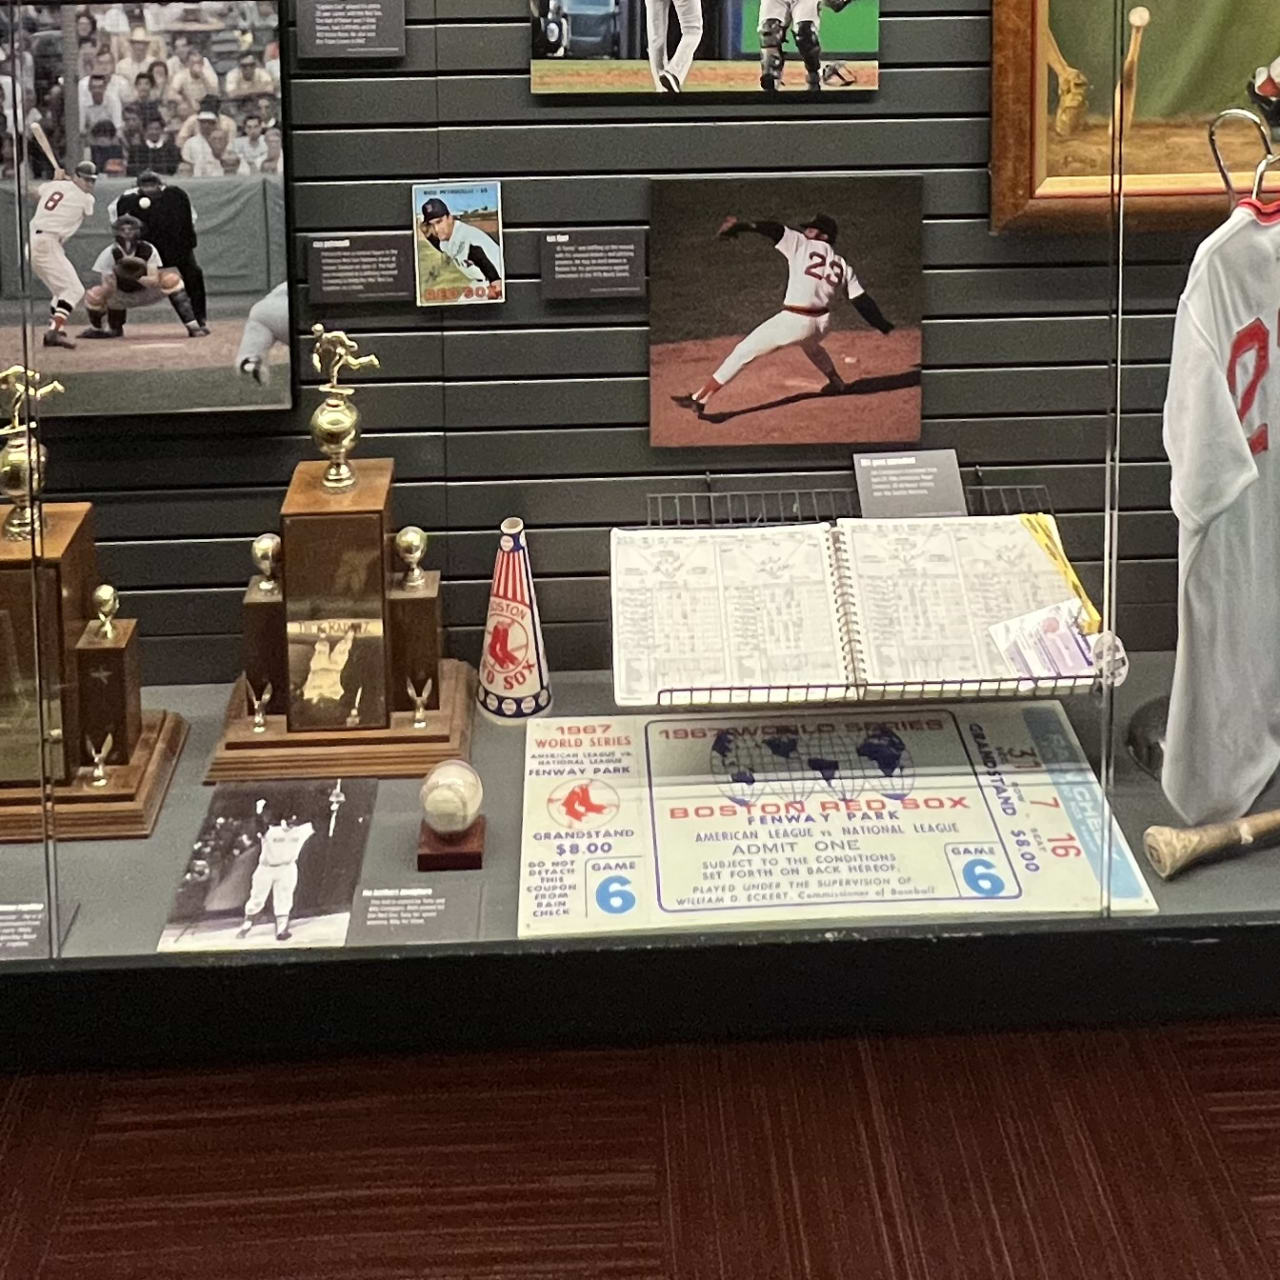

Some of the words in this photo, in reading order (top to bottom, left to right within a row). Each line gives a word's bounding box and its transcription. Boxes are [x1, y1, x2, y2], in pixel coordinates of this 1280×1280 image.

[44, 191, 64, 211] 8
[804, 251, 844, 288] 23
[503, 660, 536, 691] SOX
[554, 724, 613, 735] 1967
[659, 727, 720, 740] 1967
[725, 722, 836, 738] WORLD
[845, 719, 944, 732] SERIES
[535, 737, 583, 749] WORLD
[589, 736, 632, 747] SERIES
[528, 768, 587, 777] FENWAY
[593, 766, 631, 775] PARK
[969, 722, 1017, 817] GRANDSTAND
[1010, 829, 1040, 873] $8.00
[669, 800, 806, 819] BOSTON
[820, 799, 887, 812] RED
[901, 796, 970, 810] SOX
[747, 813, 832, 826] FENWAY
[848, 810, 900, 821] PARK
[532, 829, 635, 841] GRANDSTAND
[695, 831, 759, 843] AMERICAN
[768, 828, 814, 839] LEAGUE
[842, 824, 905, 836] NATIONAL
[914, 823, 960, 834] LEAGUE
[1030, 797, 1060, 809] 7
[1047, 833, 1082, 858] 16
[555, 842, 613, 856] $8.00
[732, 841, 798, 856] ADMIT
[814, 839, 860, 852] ONE
[951, 846, 996, 856] GAME
[527, 860, 546, 869] DO
[551, 860, 576, 868] NOT
[591, 861, 636, 872] GAME
[702, 858, 754, 869] SUBJECT
[761, 858, 779, 867] TO
[786, 856, 808, 865] THE
[816, 853, 897, 864] CONDITIONS
[528, 868, 575, 876] DETACH
[702, 871, 721, 881] SET
[730, 869, 773, 879] FORTH
[780, 868, 800, 876] ON
[807, 866, 840, 875] BACK
[962, 858, 1005, 897] 6
[526, 884, 577, 893] COUPON
[692, 884, 736, 894] PLAYED
[742, 881, 781, 891] UNDER
[789, 880, 810, 889] THE
[817, 877, 891, 888] SUPERVISION
[534, 892, 569, 901] FROM
[595, 875, 636, 914] 6
[676, 895, 724, 906] WILLIAM
[797, 889, 869, 900] Commissioner
[891, 885, 935, 896] Baseball
[536, 900, 567, 908] RAIN
[532, 909, 570, 917] CHECK
